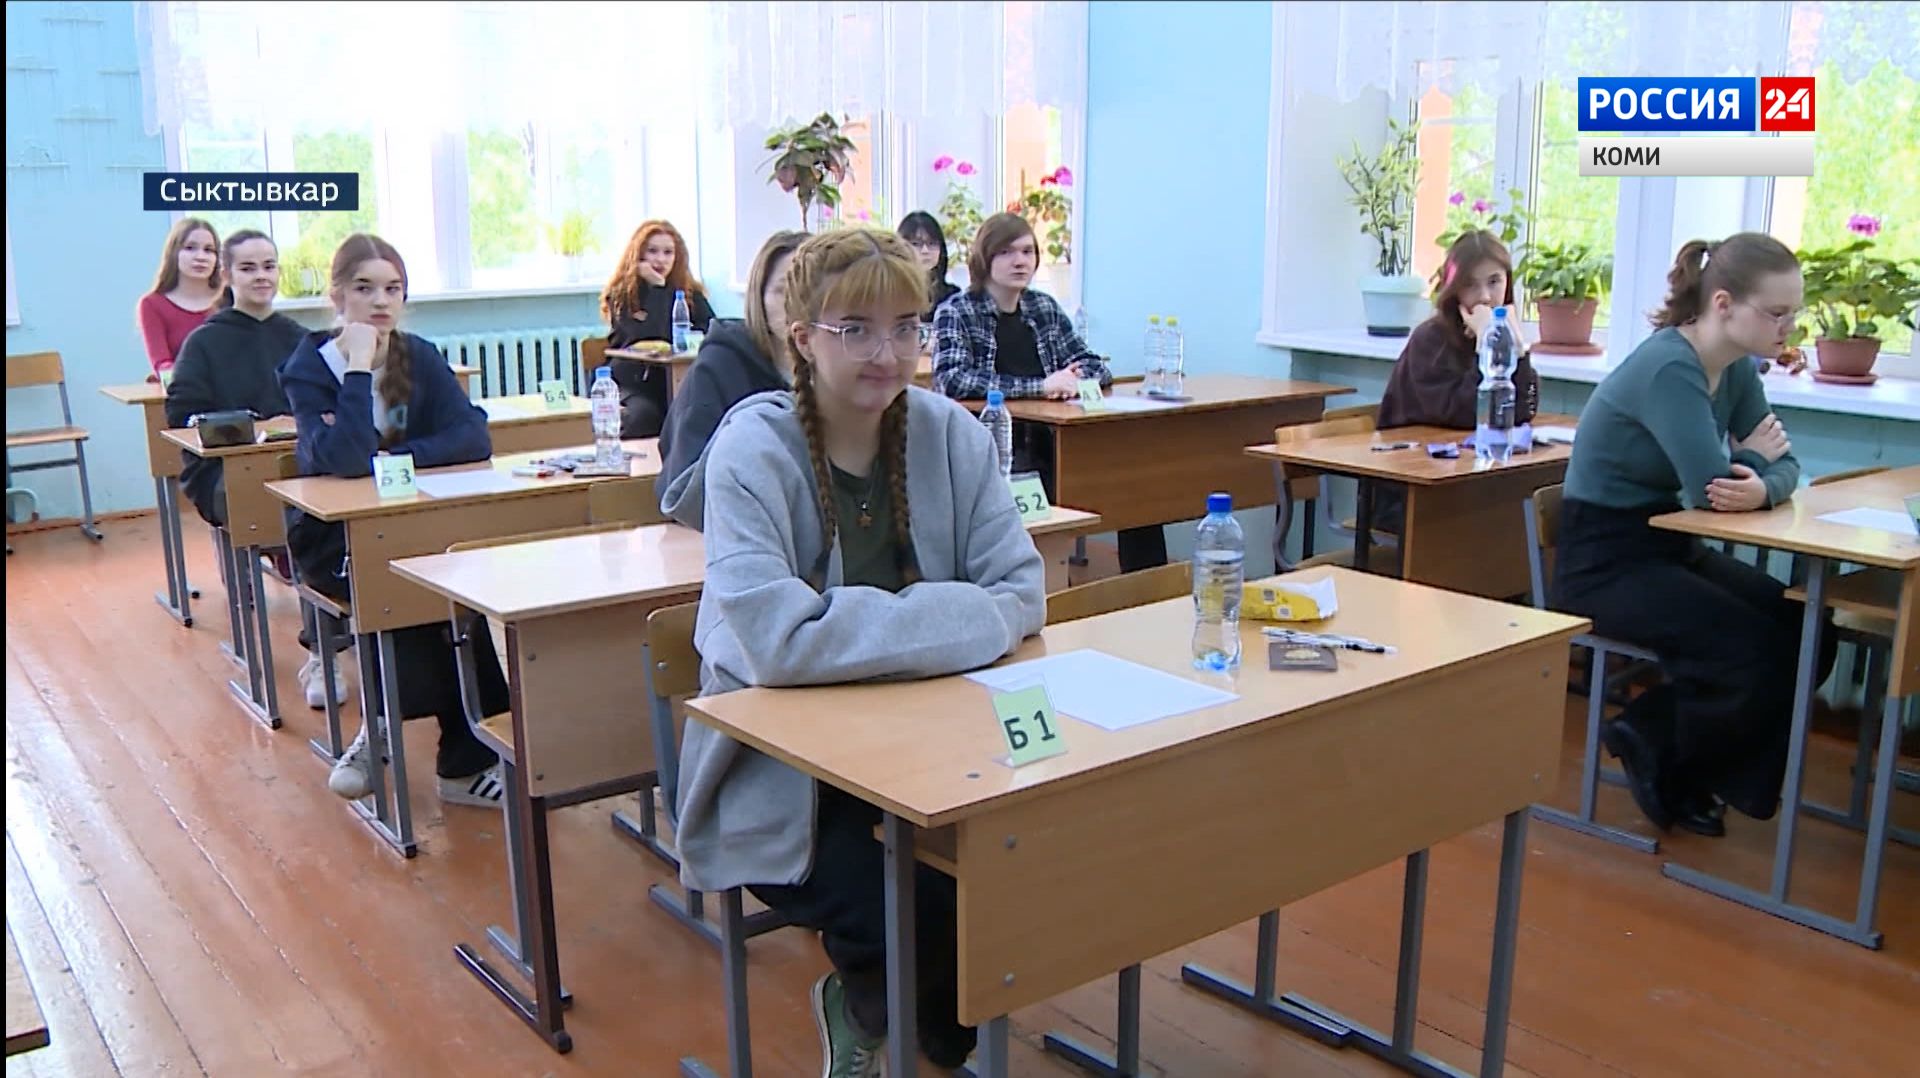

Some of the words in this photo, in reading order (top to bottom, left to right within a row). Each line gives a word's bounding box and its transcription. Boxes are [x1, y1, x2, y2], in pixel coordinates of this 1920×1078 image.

[400, 468, 411, 485] 3
[1014, 495, 1029, 514] Б
[1031, 492, 1047, 511] 2
[1004, 716, 1029, 751] Б
[1033, 709, 1056, 741] 1
